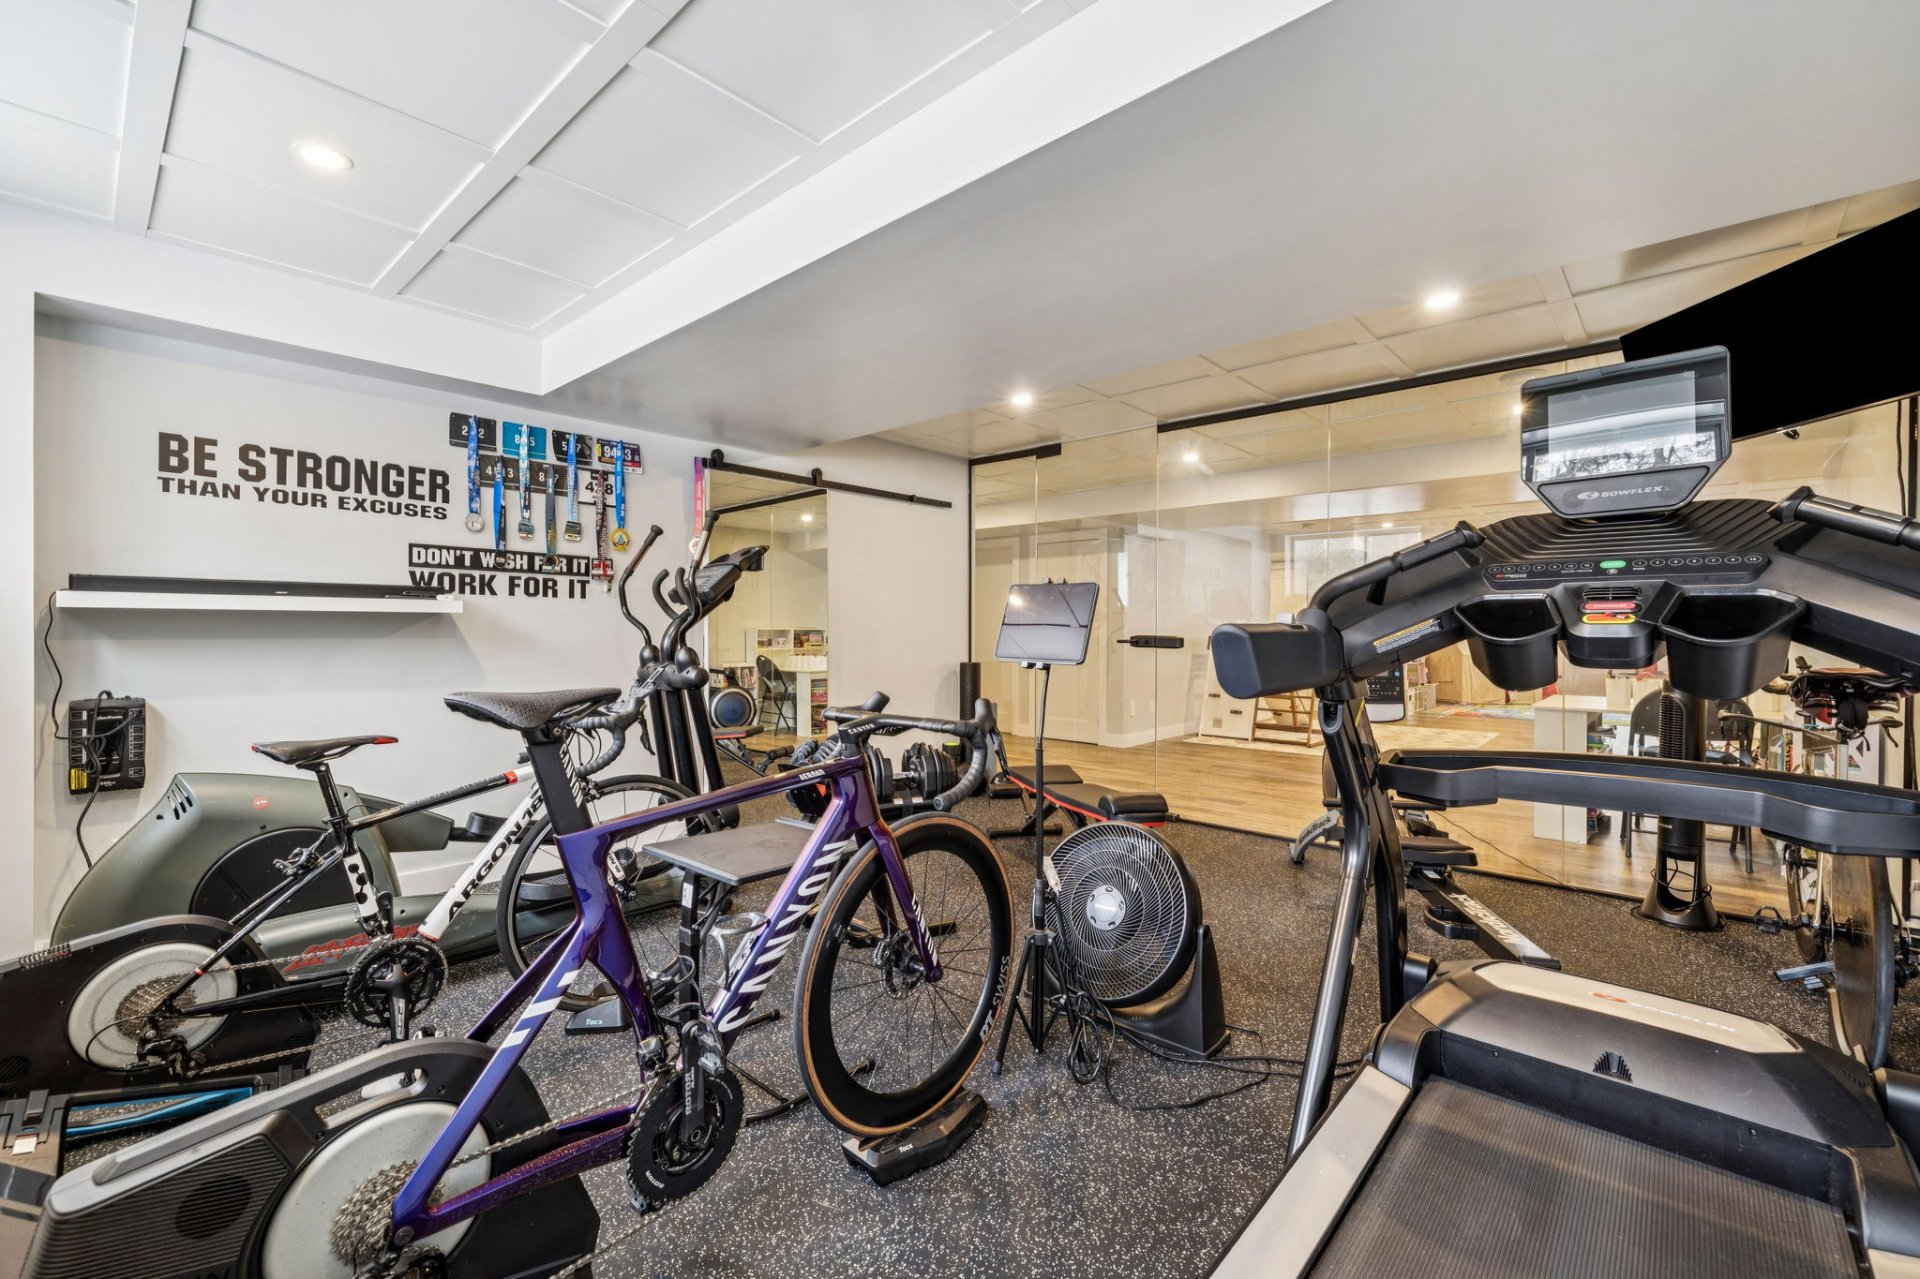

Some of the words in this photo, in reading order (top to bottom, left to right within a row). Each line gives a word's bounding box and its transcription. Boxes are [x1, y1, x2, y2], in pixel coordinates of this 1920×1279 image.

[461, 425, 485, 439] 22
[514, 434, 535, 447] 85
[158, 431, 218, 478] BE
[238, 443, 450, 504] STRONGER
[603, 445, 632, 461] 943
[157, 476, 241, 500] THAN
[252, 486, 328, 508] YOUR
[338, 496, 448, 520] EXCUSES
[1601, 485, 1663, 498] BOWFLEX
[412, 546, 474, 567] DON'T
[480, 551, 528, 570] WSH
[534, 553, 568, 573] FR
[572, 558, 588, 574] IT
[409, 570, 498, 596] WORK
[508, 575, 558, 599] FOR
[568, 579, 590, 599] IT
[847, 722, 876, 735] CANYON
[449, 820, 523, 923] ARGON
[521, 795, 544, 821] 18
[718, 838, 852, 1033] CANYON
[993, 955, 1010, 1006] SWISS
[684, 1072, 692, 1116] ROTOR
